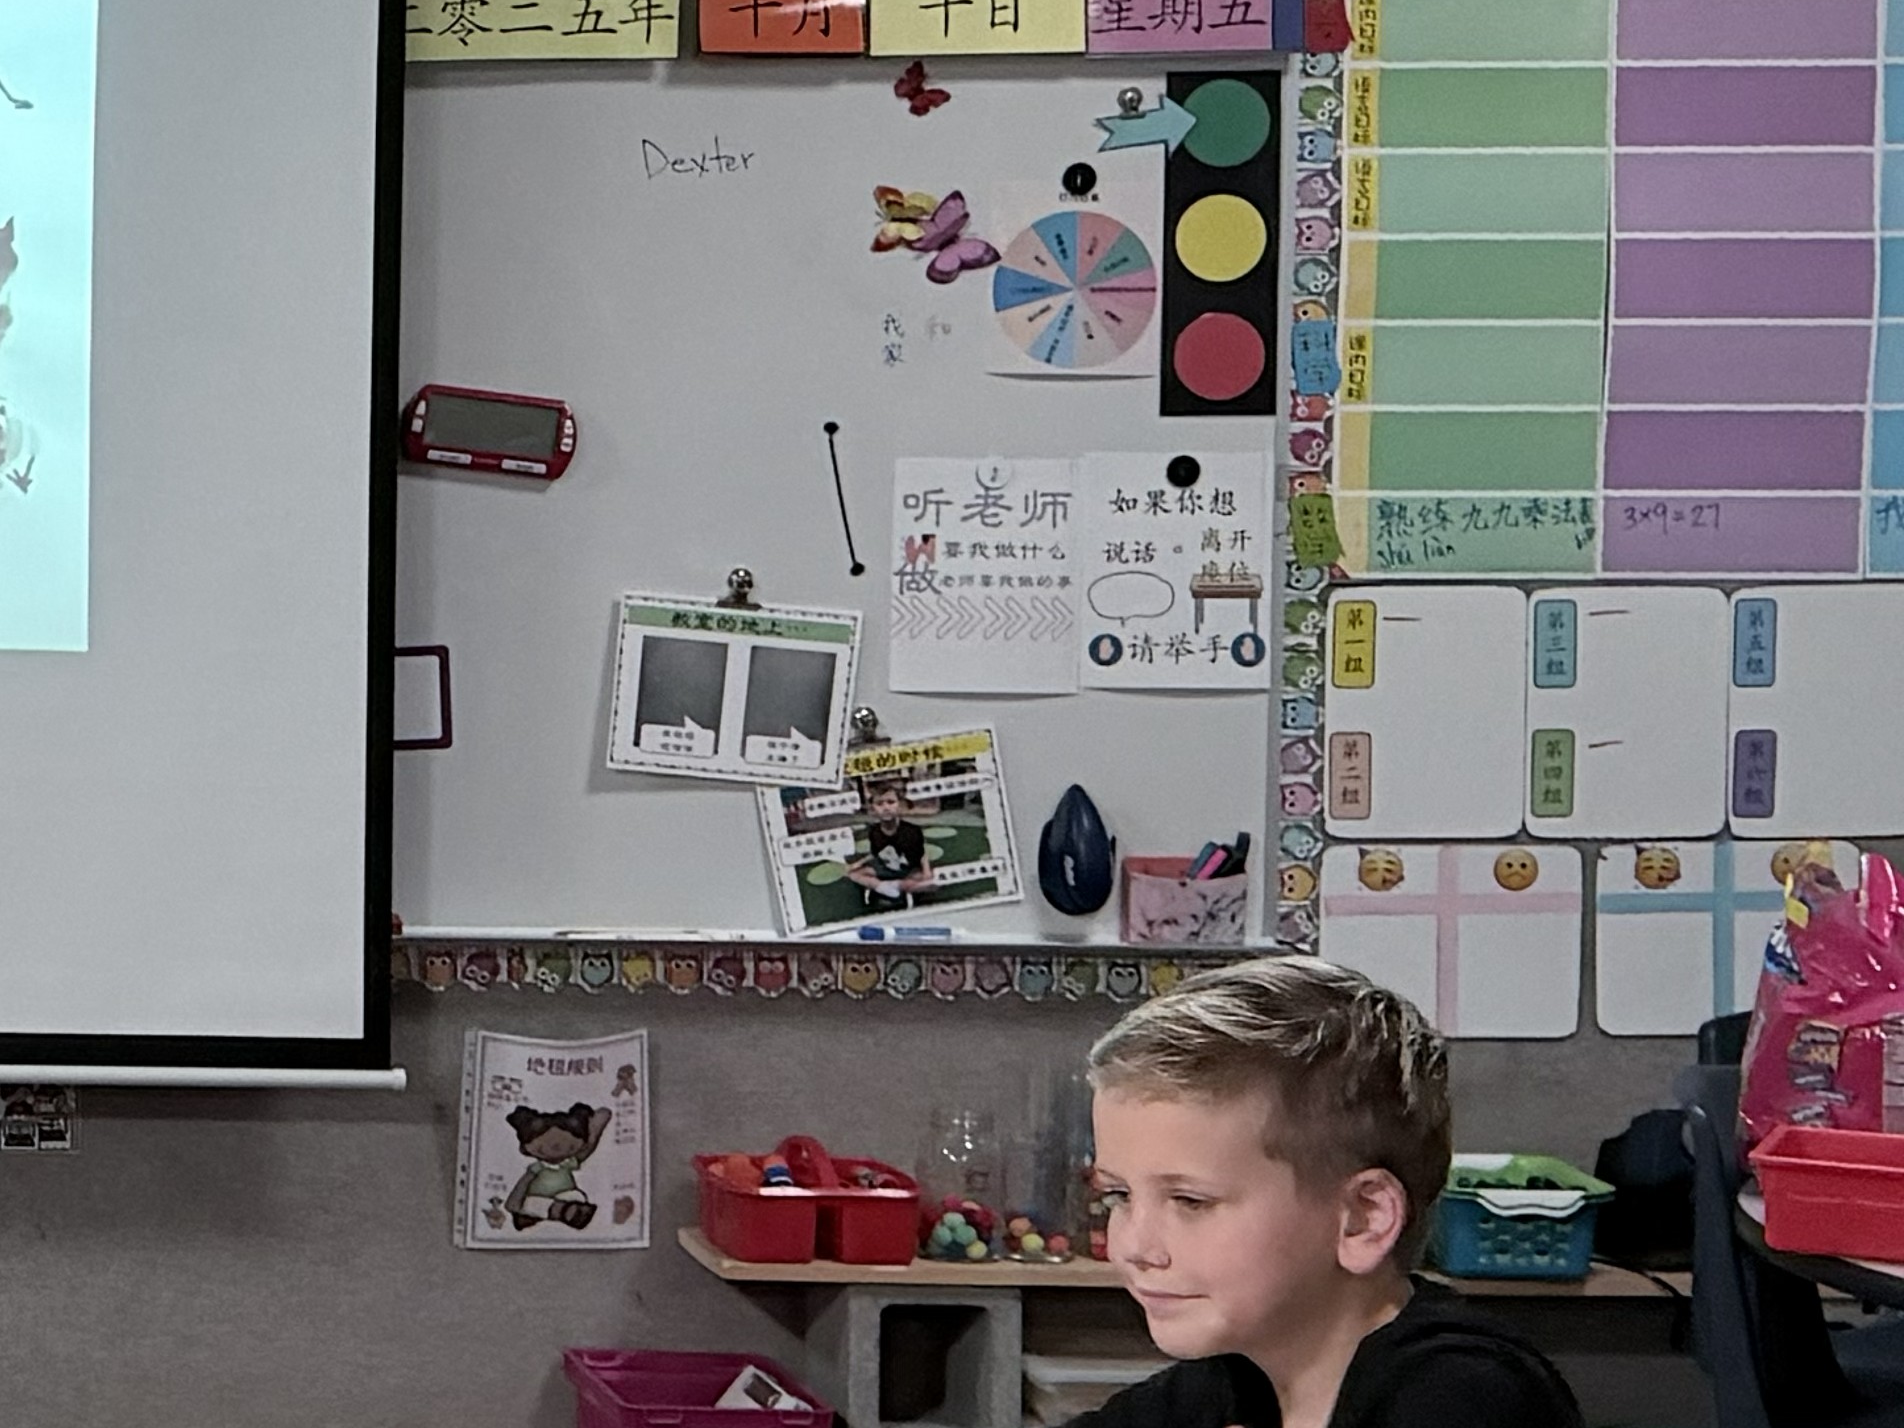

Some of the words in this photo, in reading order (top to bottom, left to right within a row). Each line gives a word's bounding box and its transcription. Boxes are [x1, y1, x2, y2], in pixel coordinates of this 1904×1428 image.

[643, 136, 755, 179] Dexter
[903, 488, 1072, 529] 听老师
[1109, 488, 1236, 516] 如果你想
[1128, 632, 1230, 664] 请举手
